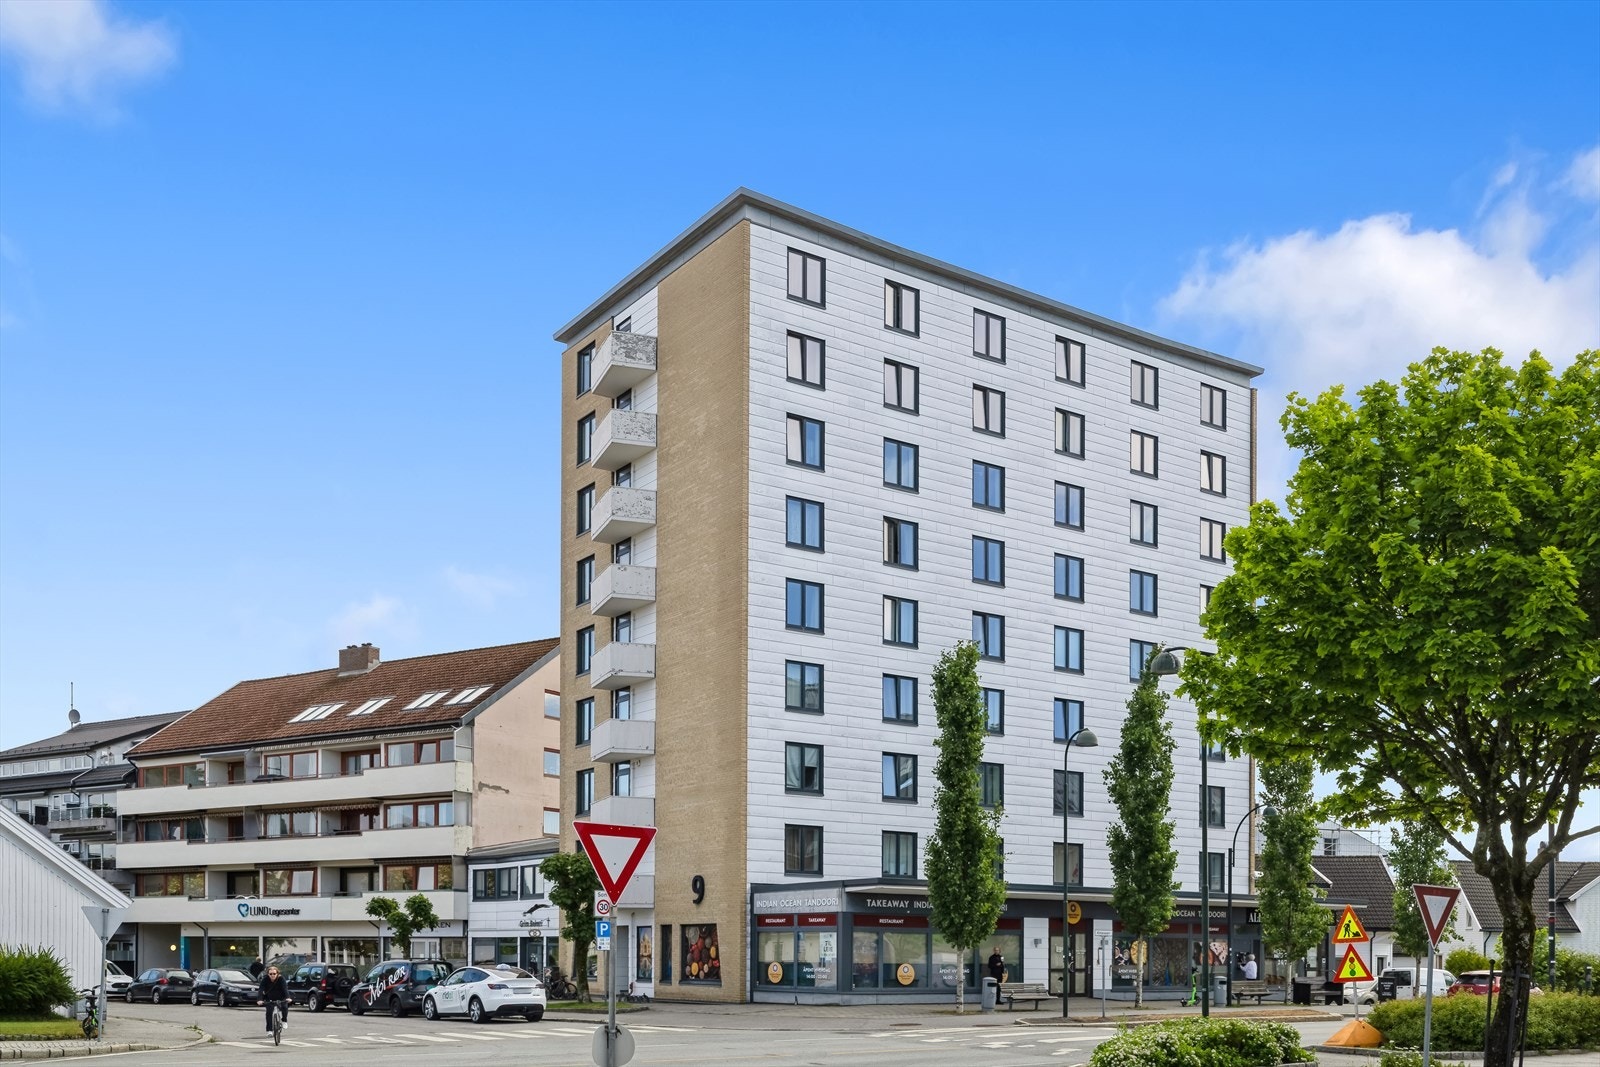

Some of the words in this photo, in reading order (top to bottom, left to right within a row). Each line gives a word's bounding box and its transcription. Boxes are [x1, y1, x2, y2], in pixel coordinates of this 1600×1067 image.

[692, 875, 705, 904] 9
[599, 903, 608, 911] 30
[756, 900, 778, 908] INDIAN
[779, 899, 802, 907] OCEAN
[805, 897, 839, 907] TANDOORI
[866, 899, 910, 908] TAKEAWAY
[913, 900, 934, 909] INDIA
[249, 906, 269, 916] LUND
[1176, 910, 1196, 918] OCEAN
[1198, 910, 1227, 919] TDOORI
[600, 923, 609, 936] P
